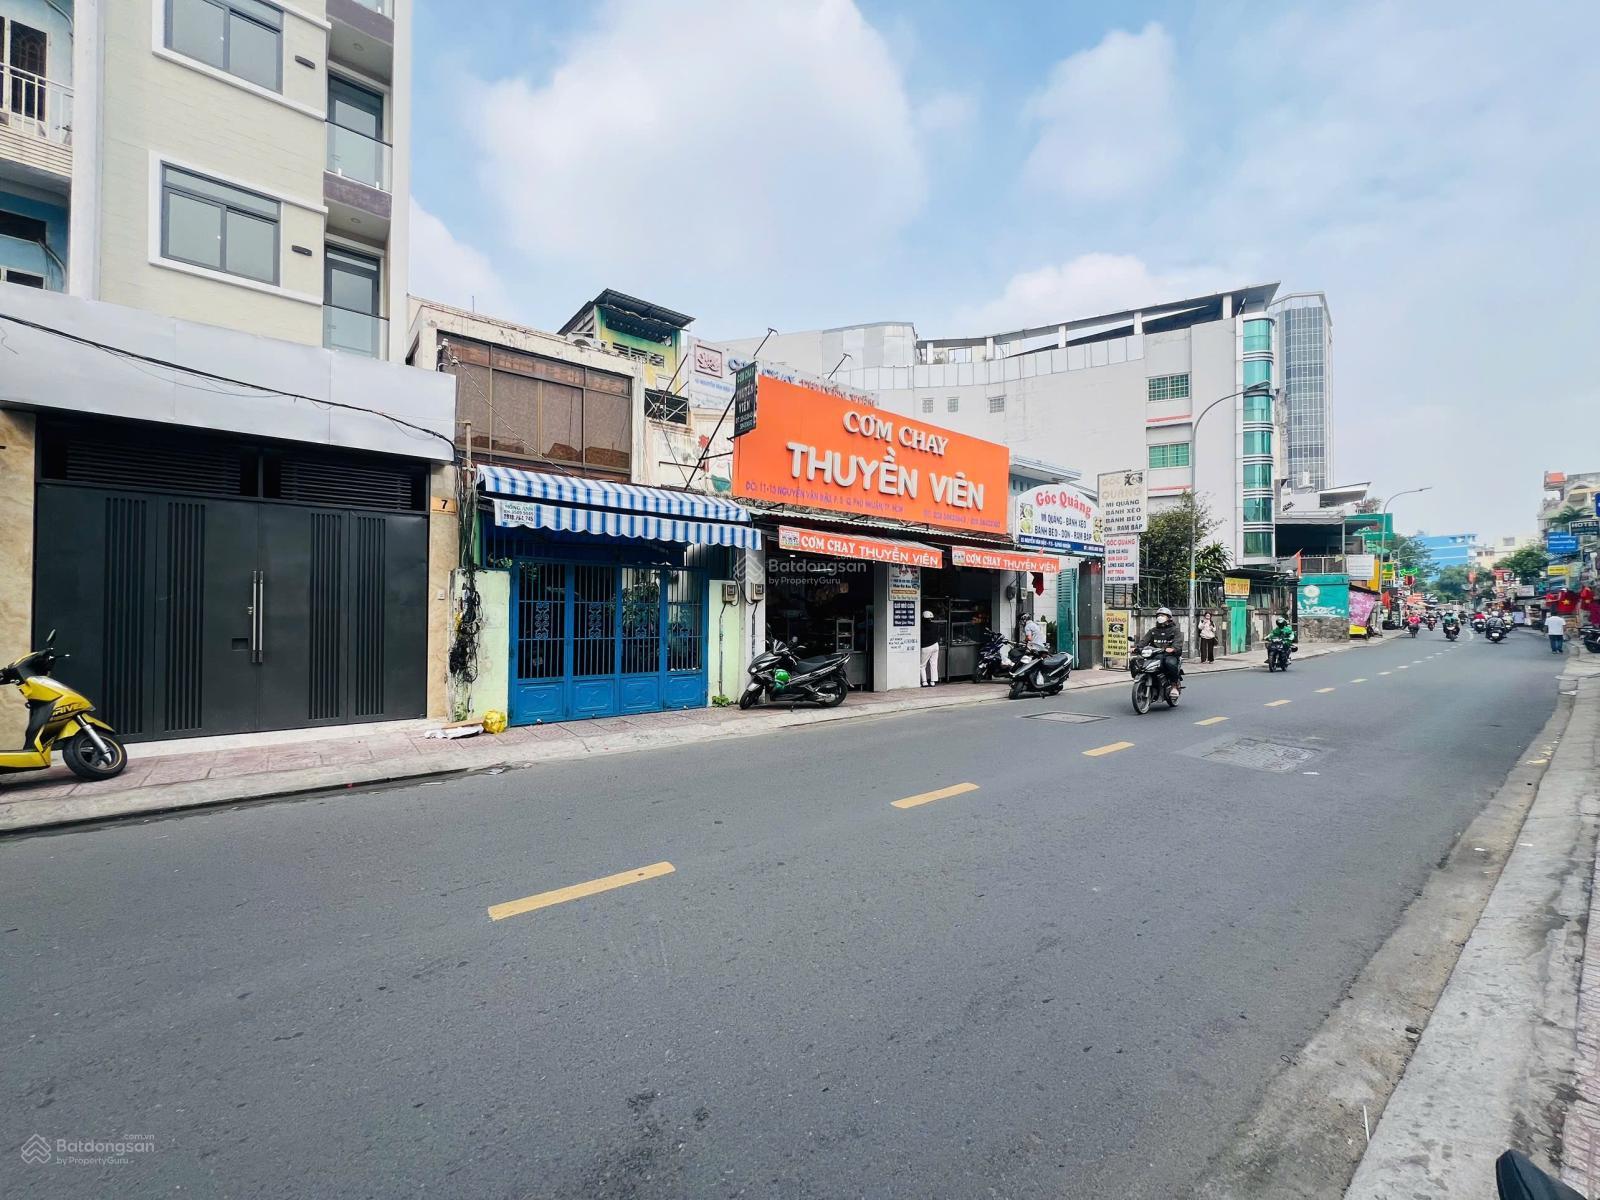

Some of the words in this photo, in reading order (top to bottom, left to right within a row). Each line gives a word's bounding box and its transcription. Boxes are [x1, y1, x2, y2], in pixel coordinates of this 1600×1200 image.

[843, 410, 893, 443] CƠM
[898, 425, 949, 456] CHAY
[786, 441, 919, 499] THUYỀN
[441, 499, 448, 509] 7
[928, 471, 984, 511] VIÊN
[1036, 490, 1057, 507] Góc
[1060, 491, 1093, 519] Quảng
[801, 534, 825, 550] CƠM
[827, 539, 855, 554] CHAY
[858, 541, 909, 563] THUYỀN
[912, 550, 939, 567] VIÊN
[983, 554, 1001, 567] CHAY
